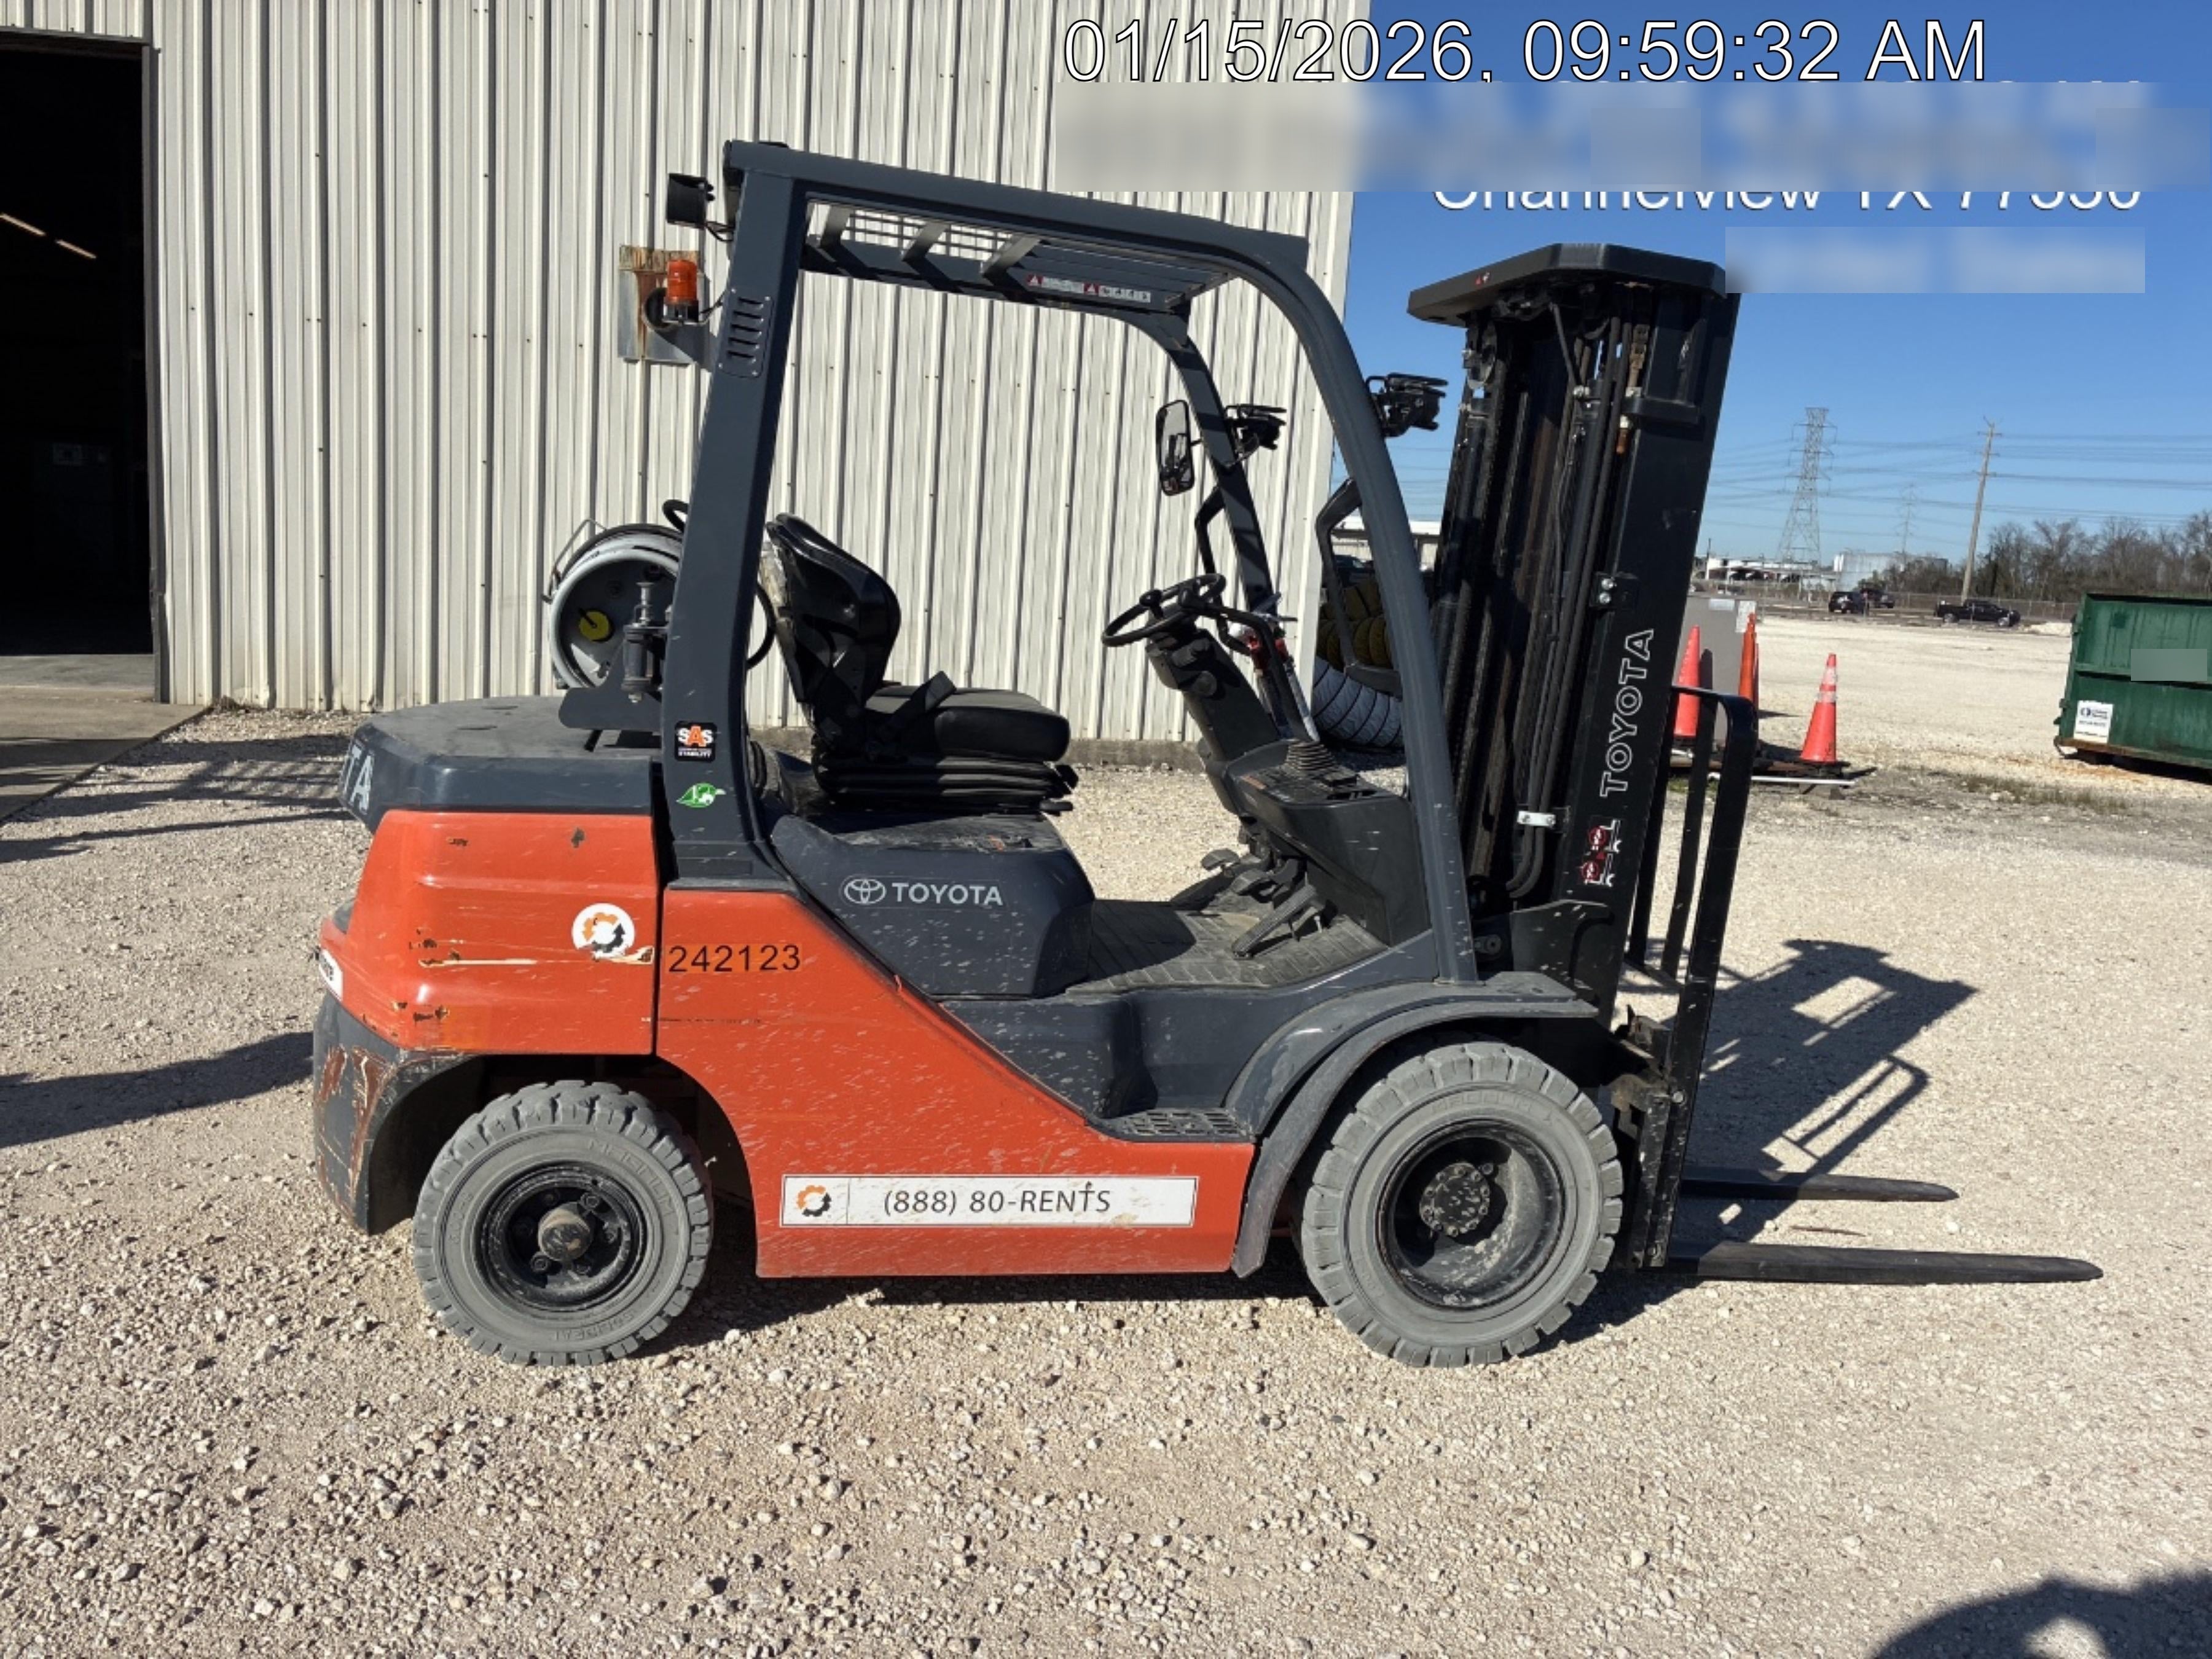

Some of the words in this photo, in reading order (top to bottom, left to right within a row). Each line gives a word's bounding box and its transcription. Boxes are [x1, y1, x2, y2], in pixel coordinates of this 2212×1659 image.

[1600, 629, 1654, 798] TOYOTA
[677, 726, 713, 747] SAS
[892, 882, 1003, 906] TOYOTA
[669, 945, 800, 973] 242123
[883, 1188, 957, 1216] (888)
[969, 1188, 1111, 1214] 80-RENTS
